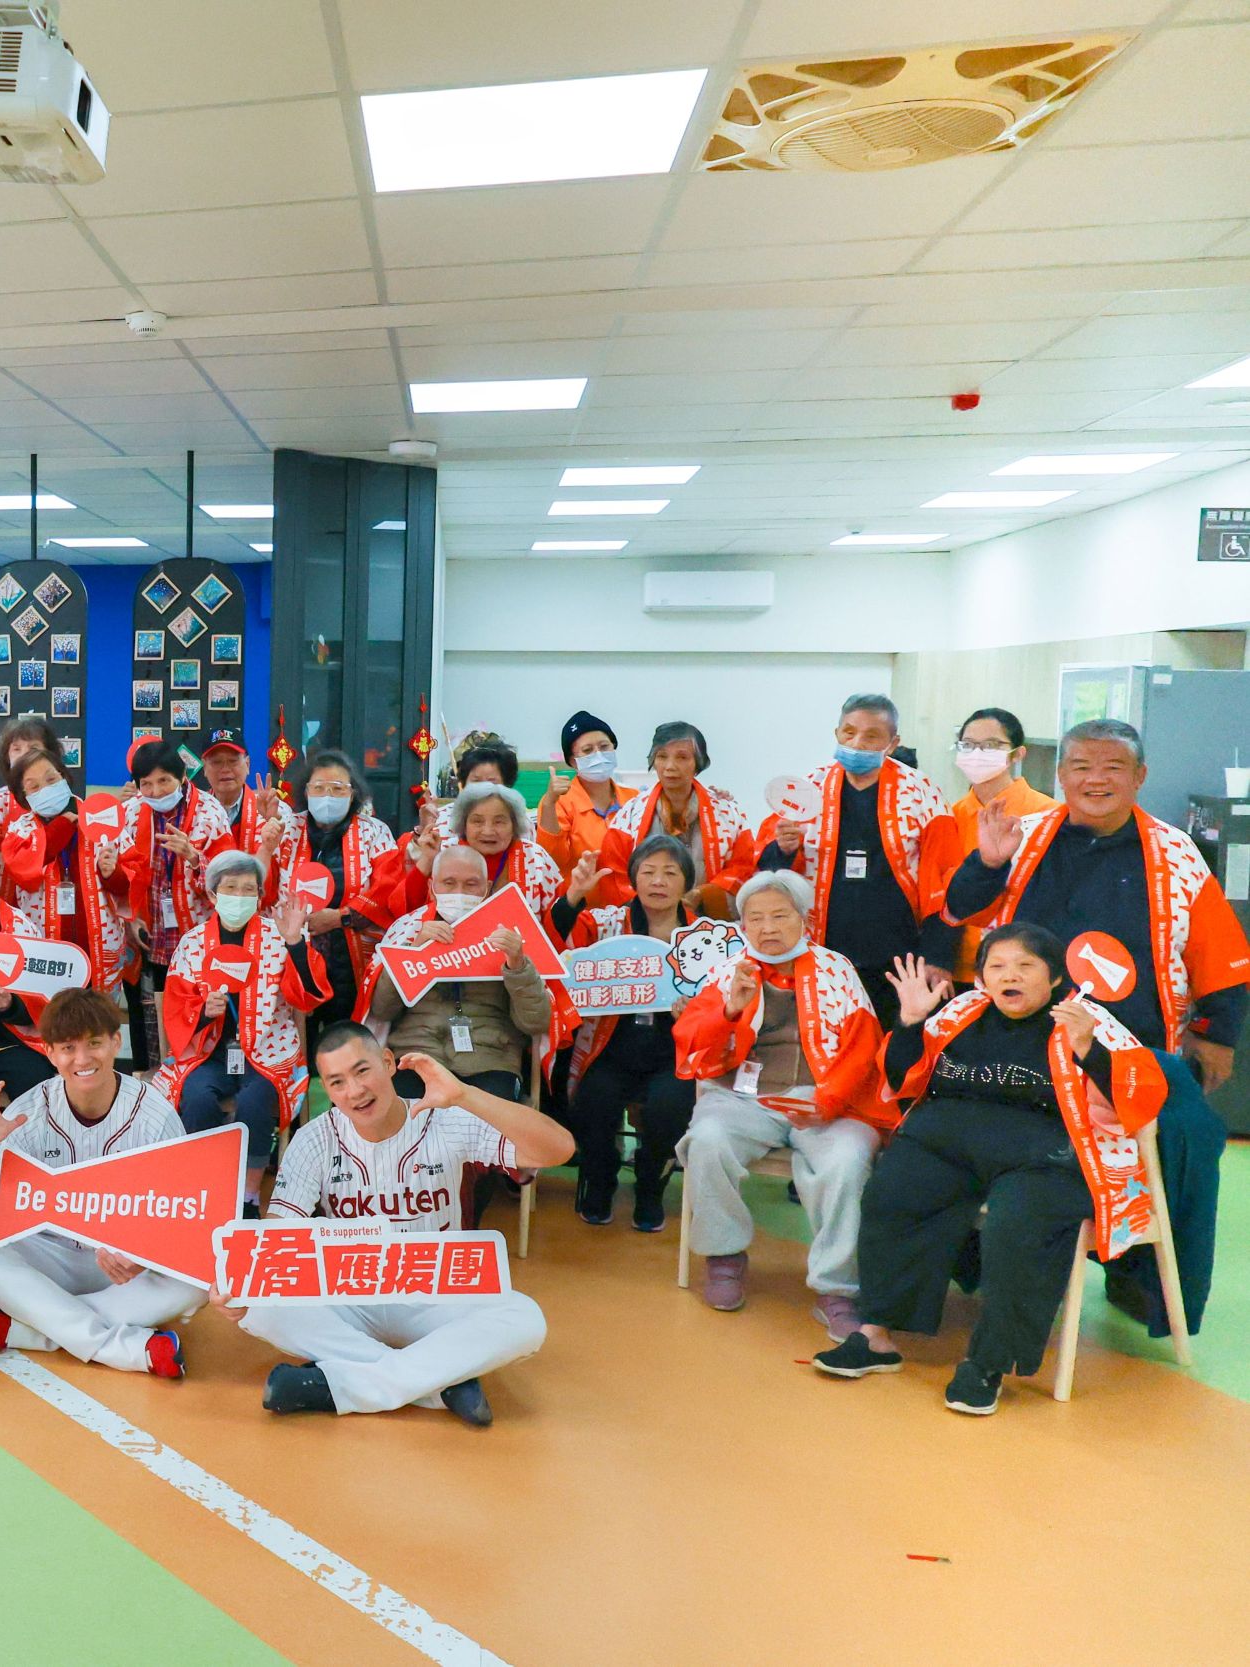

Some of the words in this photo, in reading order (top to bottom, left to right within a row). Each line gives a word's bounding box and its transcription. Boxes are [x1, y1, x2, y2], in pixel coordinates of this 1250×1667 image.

[402, 960, 429, 979] Be
[430, 926, 526, 969] support!
[574, 956, 663, 982] 健康支援
[568, 983, 657, 1008] 如影隨形
[1055, 1042, 1069, 1076] supporters!
[1064, 1082, 1073, 1091] Be
[1066, 1091, 1084, 1129] supporters!
[1083, 1146, 1103, 1186] supporters!
[15, 1181, 47, 1211] Be
[55, 1190, 208, 1223] supporters!
[320, 1227, 331, 1238] Be
[332, 1226, 382, 1239] supporters!
